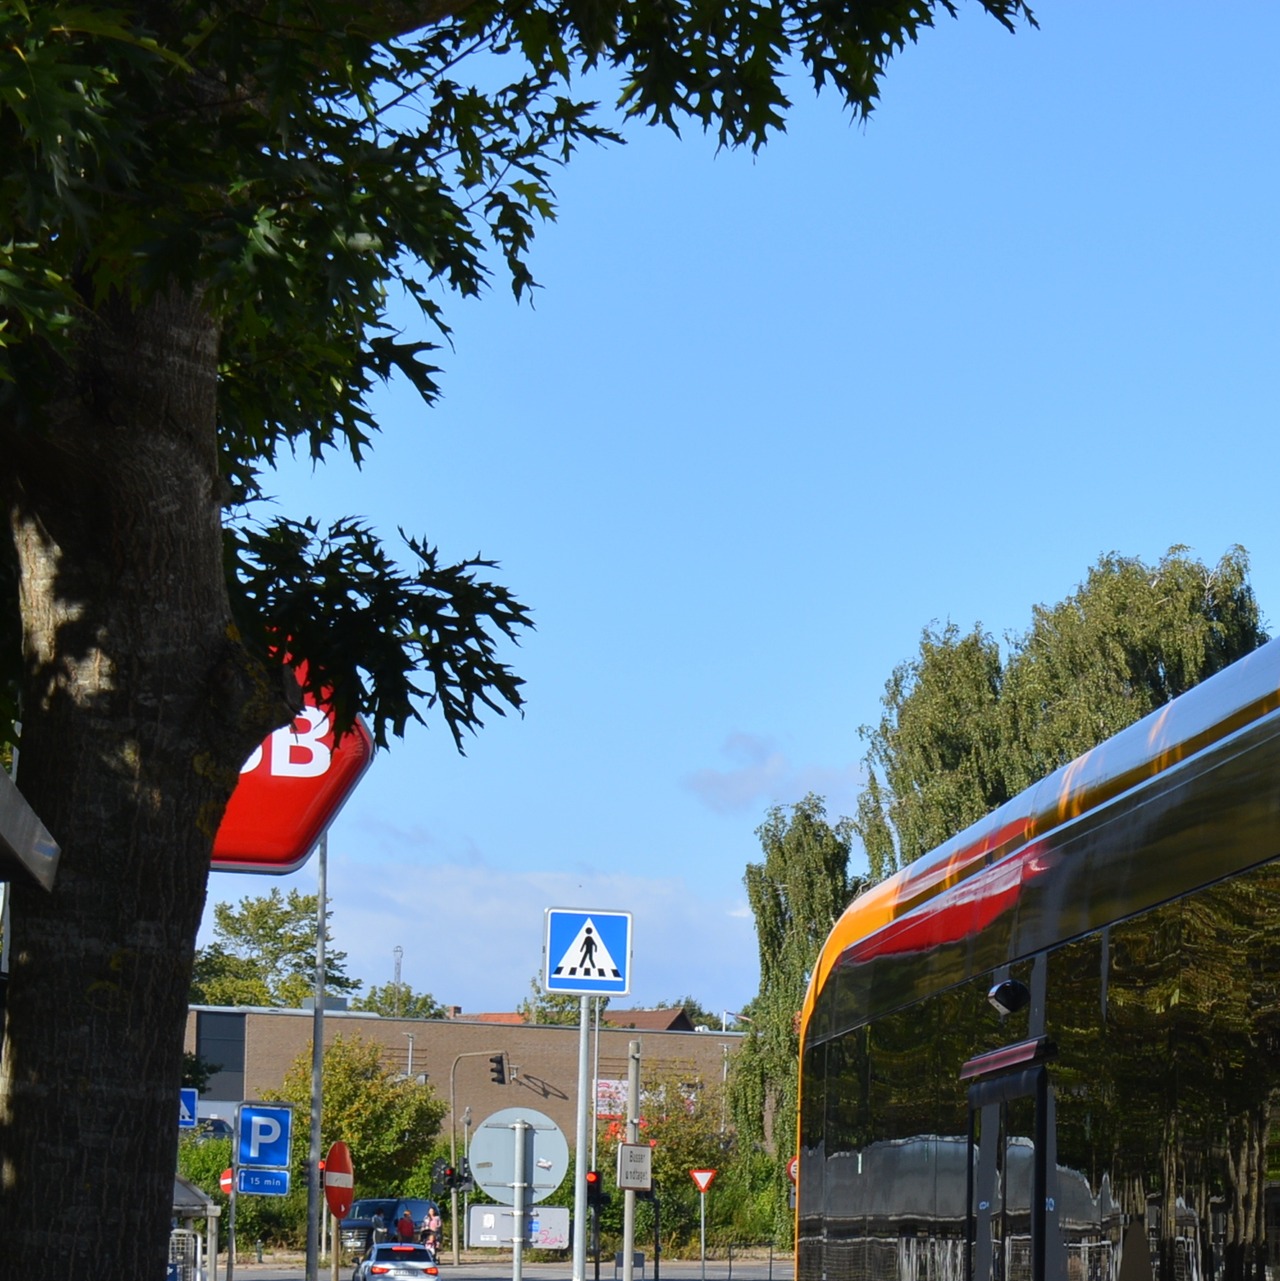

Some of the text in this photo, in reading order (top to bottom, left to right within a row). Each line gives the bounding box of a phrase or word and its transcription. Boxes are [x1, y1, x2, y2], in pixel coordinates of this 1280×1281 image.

[250, 1116, 281, 1158] P
[250, 1177, 281, 1186] 15 min
